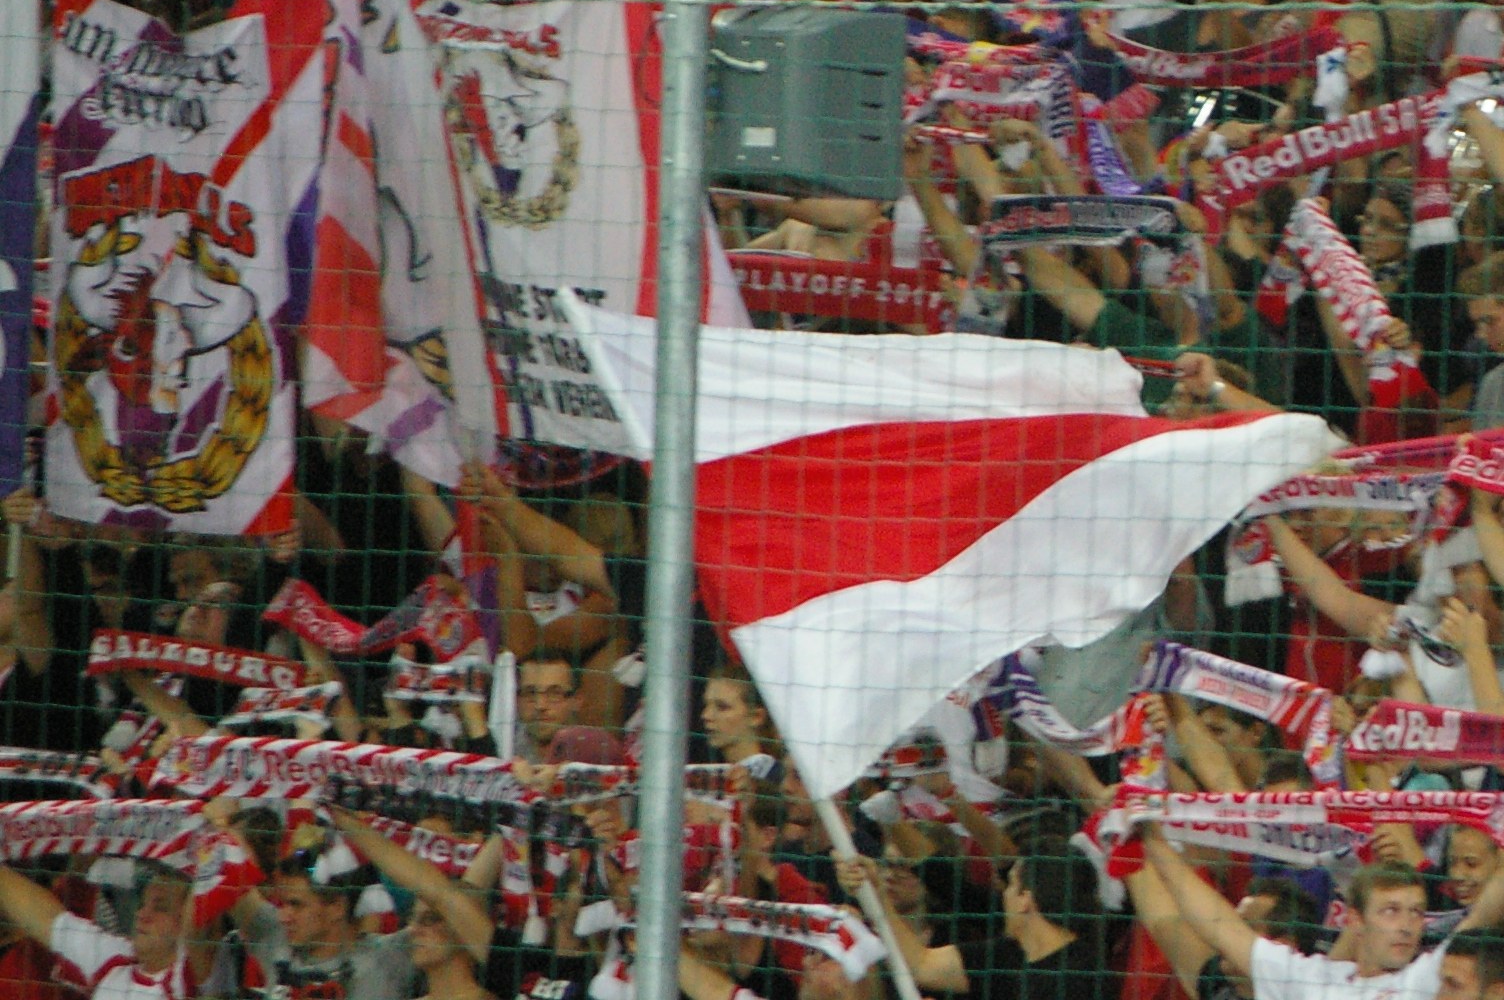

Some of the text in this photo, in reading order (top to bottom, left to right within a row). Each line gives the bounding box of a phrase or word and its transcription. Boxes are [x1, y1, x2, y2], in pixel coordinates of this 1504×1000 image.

[1223, 133, 1299, 192] Red
[1300, 111, 1376, 160] Bull
[1405, 710, 1461, 752] Bull
